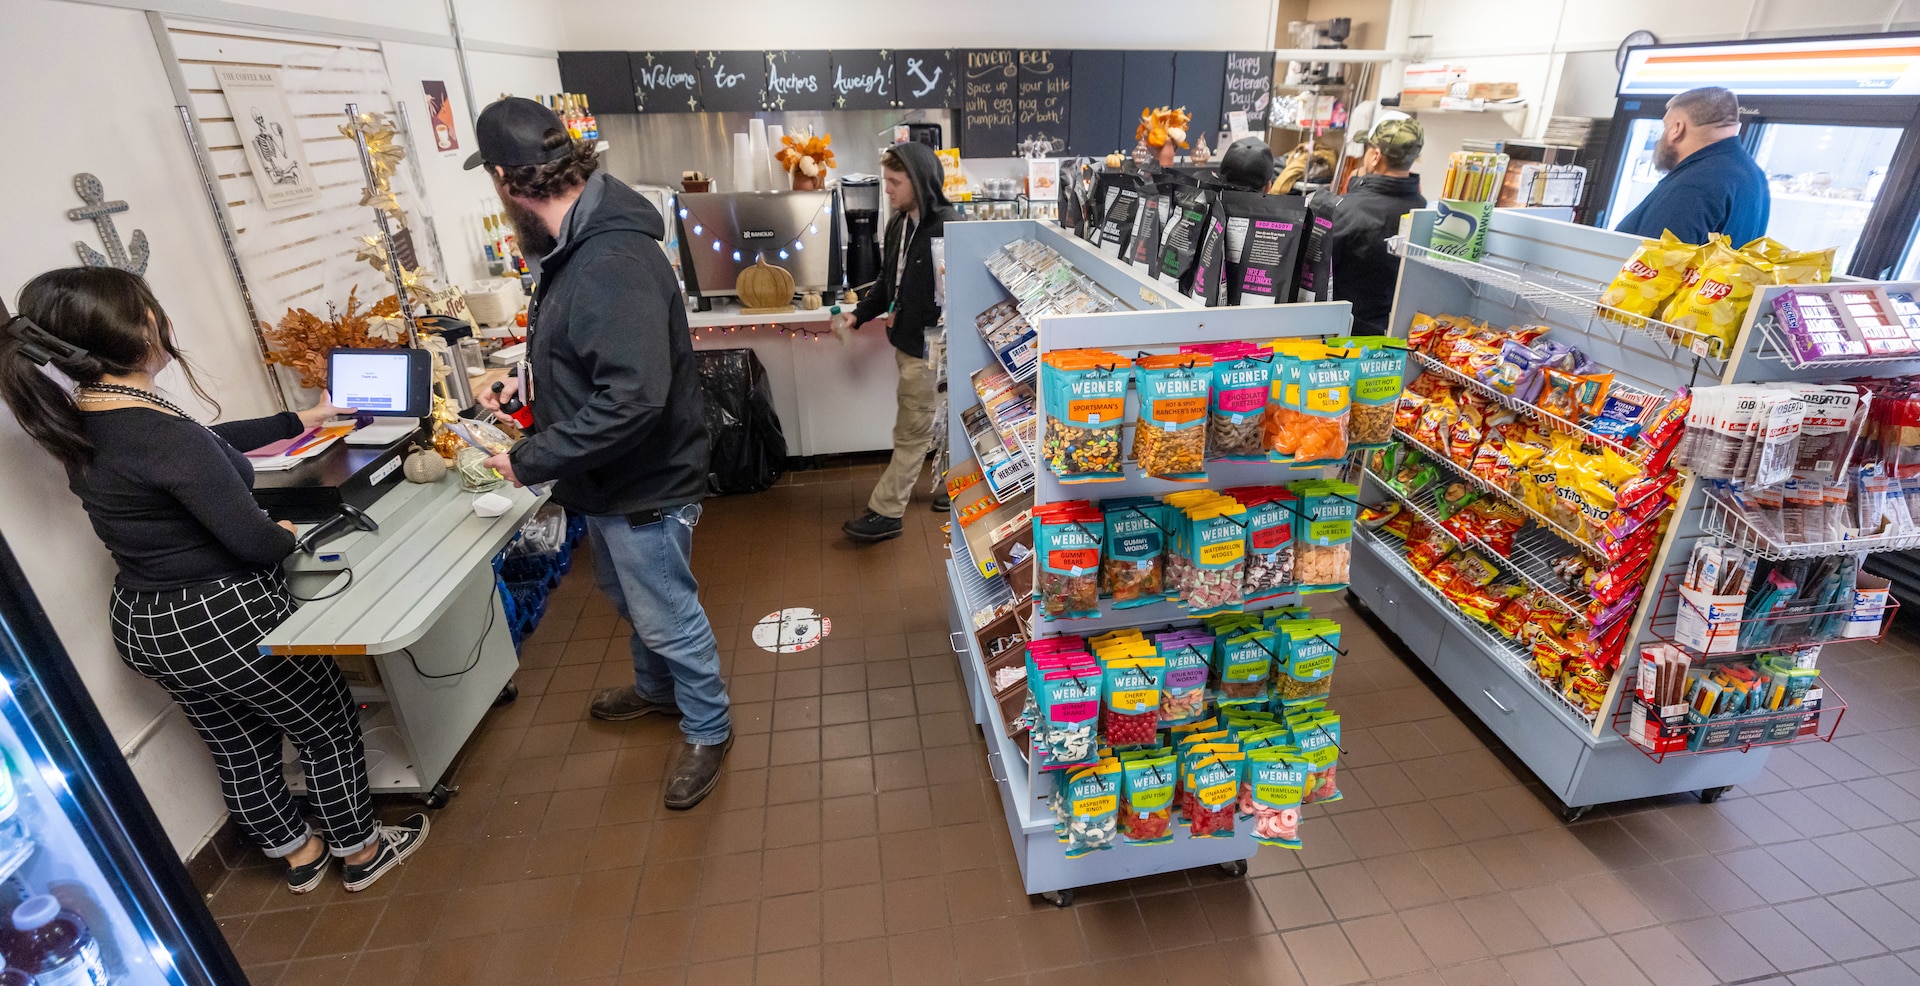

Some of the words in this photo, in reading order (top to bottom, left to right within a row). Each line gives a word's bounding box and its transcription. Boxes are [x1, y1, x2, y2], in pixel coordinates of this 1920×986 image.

[1228, 53, 1260, 76] Happy
[641, 64, 696, 90] Welcome
[714, 65, 745, 88] to
[768, 63, 818, 94] Anchors
[833, 64, 893, 95] Aweigh!
[1226, 73, 1269, 91] Veterans
[967, 82, 992, 97] Spice
[996, 82, 1008, 94] up
[1020, 81, 1043, 96] your
[1047, 77, 1070, 93] latte
[966, 97, 987, 112] with
[993, 98, 1013, 113] egg
[1020, 99, 1037, 114] nog
[1045, 97, 1057, 107] or
[1229, 91, 1256, 111] Day!
[967, 112, 1016, 130] pumpkin!
[1037, 106, 1063, 124] both!
[1472, 204, 1493, 259] SEAHAWKS
[1617, 281, 1639, 290] Classic
[1699, 278, 1732, 299] Lay's
[437, 296, 465, 318] Coffee
[1688, 306, 1710, 316] Classic
[1360, 359, 1401, 374] WERNER
[1221, 369, 1268, 385] WERNER
[1309, 370, 1350, 384] WERNER
[1071, 380, 1123, 394] WERNER
[1156, 379, 1206, 394] WERNER
[1363, 386, 1383, 394] CRUNCH
[1228, 391, 1265, 401] CHOCOLATE
[1231, 399, 1261, 408] PRETZELS
[1614, 401, 1635, 411] POTATO
[1614, 406, 1630, 415] CHIPS
[1667, 407, 1685, 423] RITZ
[1653, 420, 1668, 439] bits
[1252, 510, 1289, 527] WERNER
[1312, 506, 1351, 517] WERNER
[1114, 519, 1157, 533] WERNER
[1051, 534, 1097, 546] WERNER
[1201, 526, 1242, 541] WERNER
[1124, 544, 1148, 552] WORMS
[1204, 544, 1241, 554] WATERMELON
[1211, 551, 1233, 559] WEDGES
[1298, 644, 1333, 658] WERNER
[1169, 655, 1208, 668] WERNER
[1246, 665, 1266, 673] MANGO
[1052, 686, 1097, 700] WERNER
[1301, 732, 1337, 749] WERNER
[1313, 750, 1325, 758] FRUIT
[1133, 773, 1172, 788] WERNER
[1200, 769, 1236, 784] WERNER
[1259, 770, 1302, 782] WERNER
[1074, 782, 1115, 797] WERNER
[1205, 787, 1232, 798] CINNAMON
[1260, 786, 1299, 795] WATERMELON
[1079, 799, 1110, 809] RASPBERRY
[1212, 794, 1227, 802] BEARS
